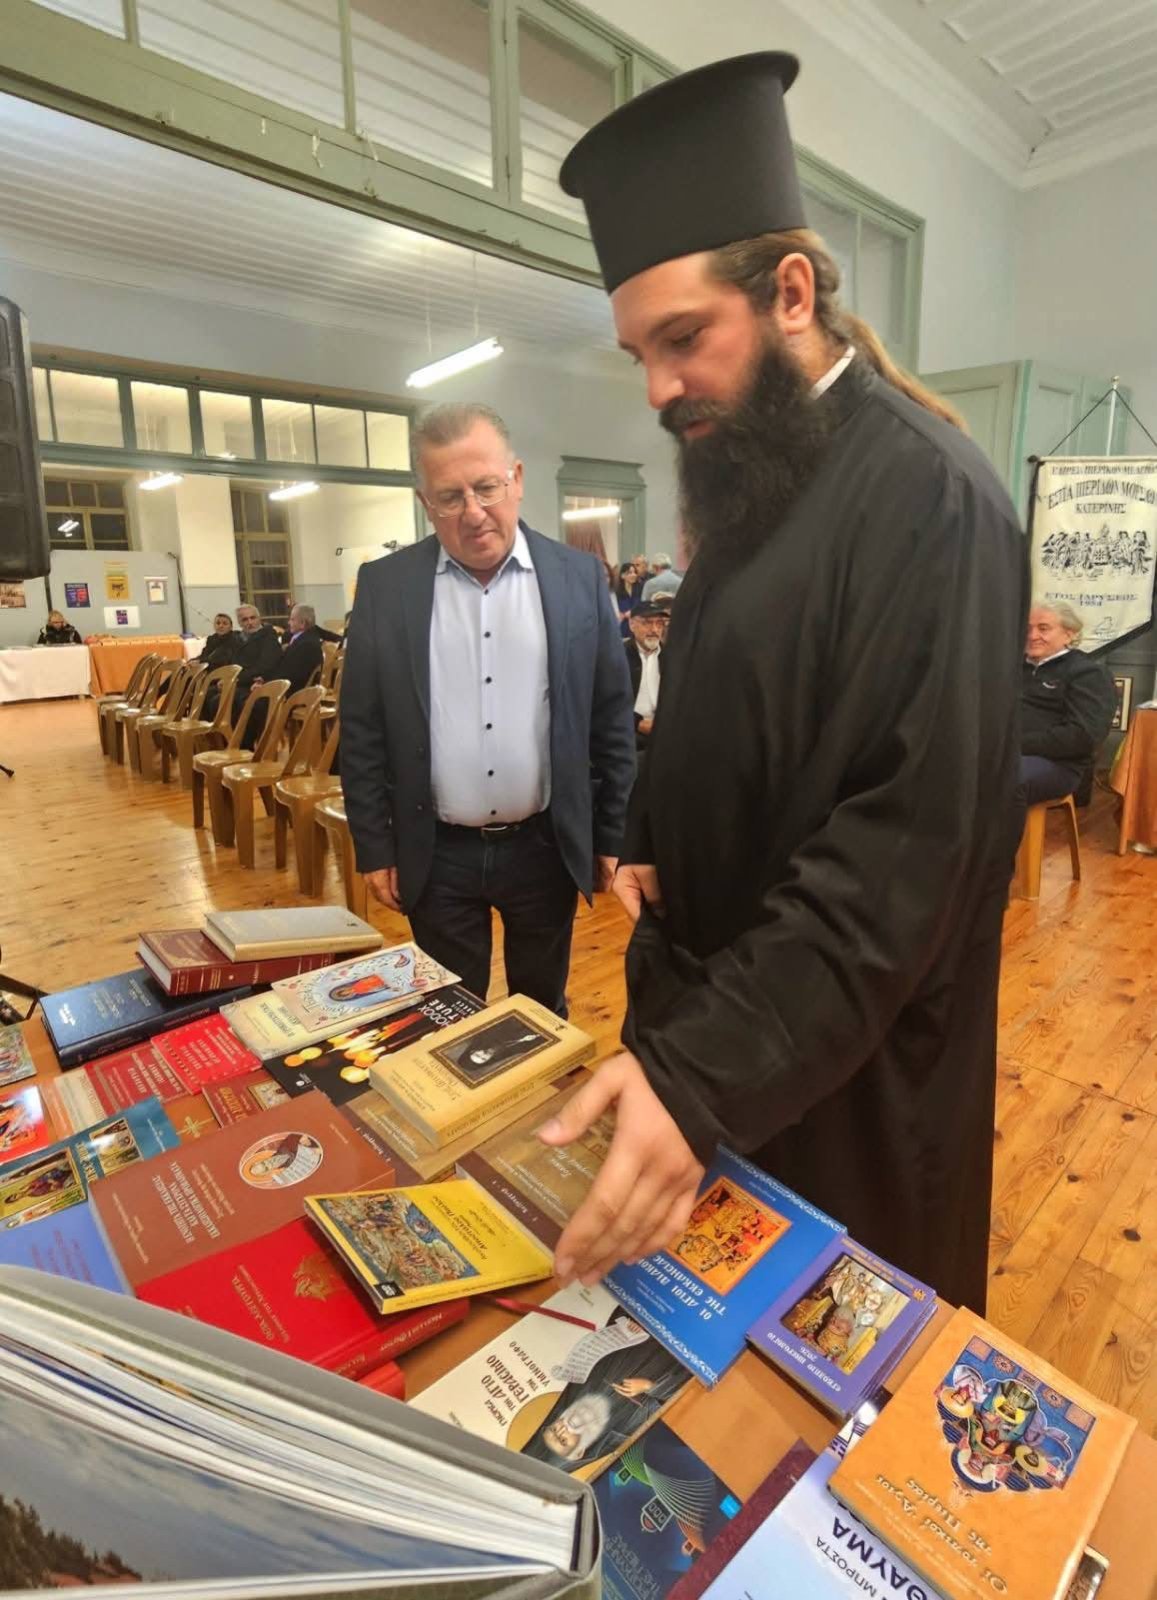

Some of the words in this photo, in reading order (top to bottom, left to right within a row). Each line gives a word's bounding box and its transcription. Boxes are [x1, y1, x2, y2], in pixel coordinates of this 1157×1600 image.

[429, 999, 464, 1020] TURE
[637, 1257, 672, 1287] ΔΙΑΚΟ
[671, 1285, 701, 1308] ΑΓΙΟΙ
[508, 1340, 551, 1387] ΥΜΝΟΓΡΑΦΟ
[480, 1375, 509, 1406] ΑΓΙΟ
[527, 1378, 539, 1392] ΤΟΝ
[815, 1536, 877, 1598] ΜΠΡΟΣΤΑ
[832, 1516, 928, 1600] ΘΑΥΜΑ
